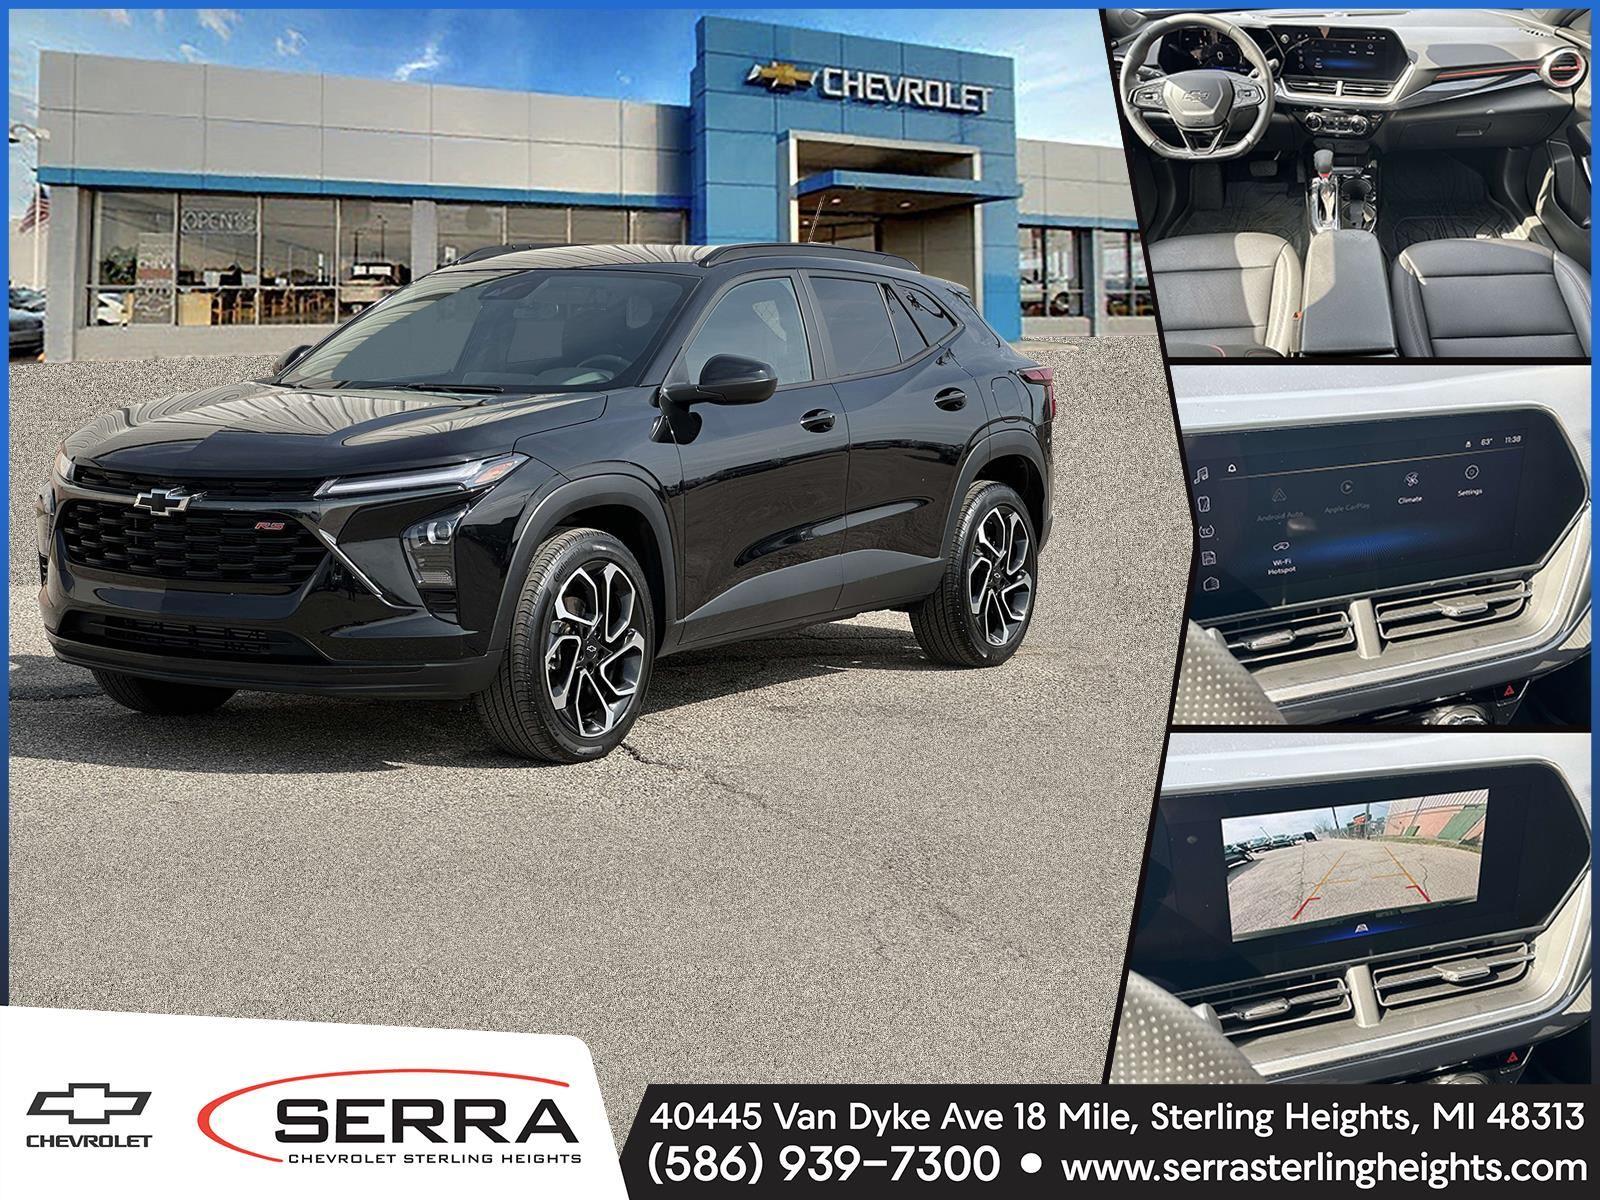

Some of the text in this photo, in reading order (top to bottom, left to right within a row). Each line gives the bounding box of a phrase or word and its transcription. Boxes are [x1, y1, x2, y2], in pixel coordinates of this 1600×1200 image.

[822, 66, 993, 113] CHEVROLET
[1457, 488, 1483, 498] Settings
[1397, 495, 1422, 504] Climate
[1324, 505, 1344, 514] Apple
[1256, 512, 1286, 522] Android
[254, 521, 286, 530] RS
[1272, 558, 1292, 567] Wi-Fi
[1267, 566, 1297, 576] Hotspot
